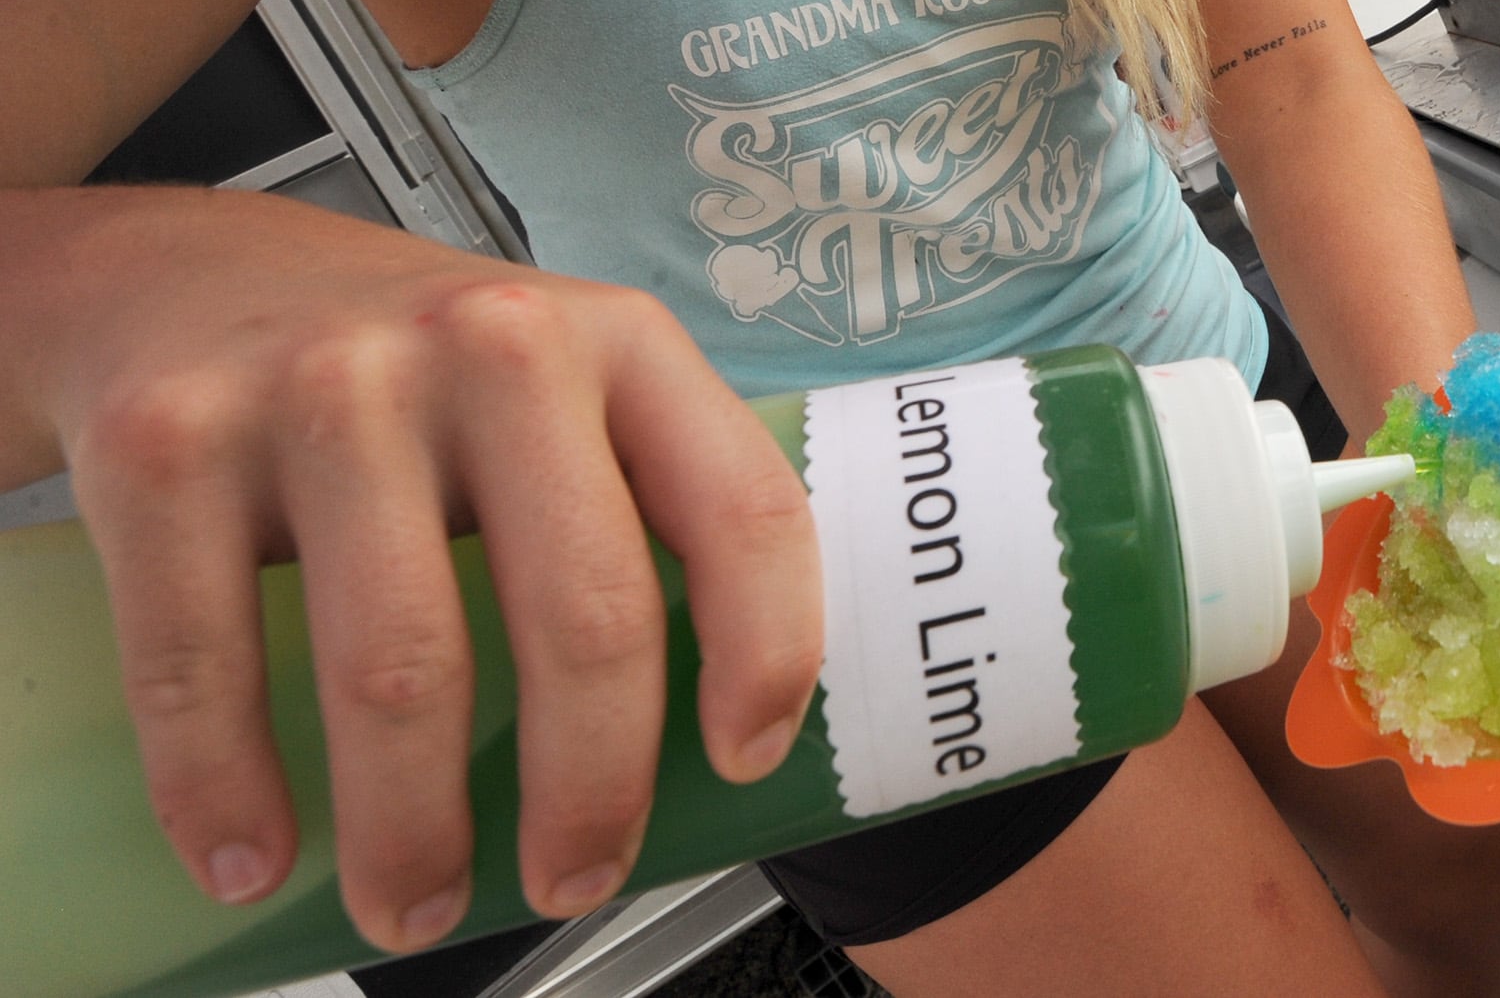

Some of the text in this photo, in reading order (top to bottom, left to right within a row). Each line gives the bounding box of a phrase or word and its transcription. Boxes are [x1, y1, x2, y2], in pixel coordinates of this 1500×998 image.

[680, 37, 1076, 240] Sweet
[1209, 19, 1327, 79] Love Never Fails
[798, 137, 1088, 340] Treats
[895, 375, 997, 777] Lemon Lime
